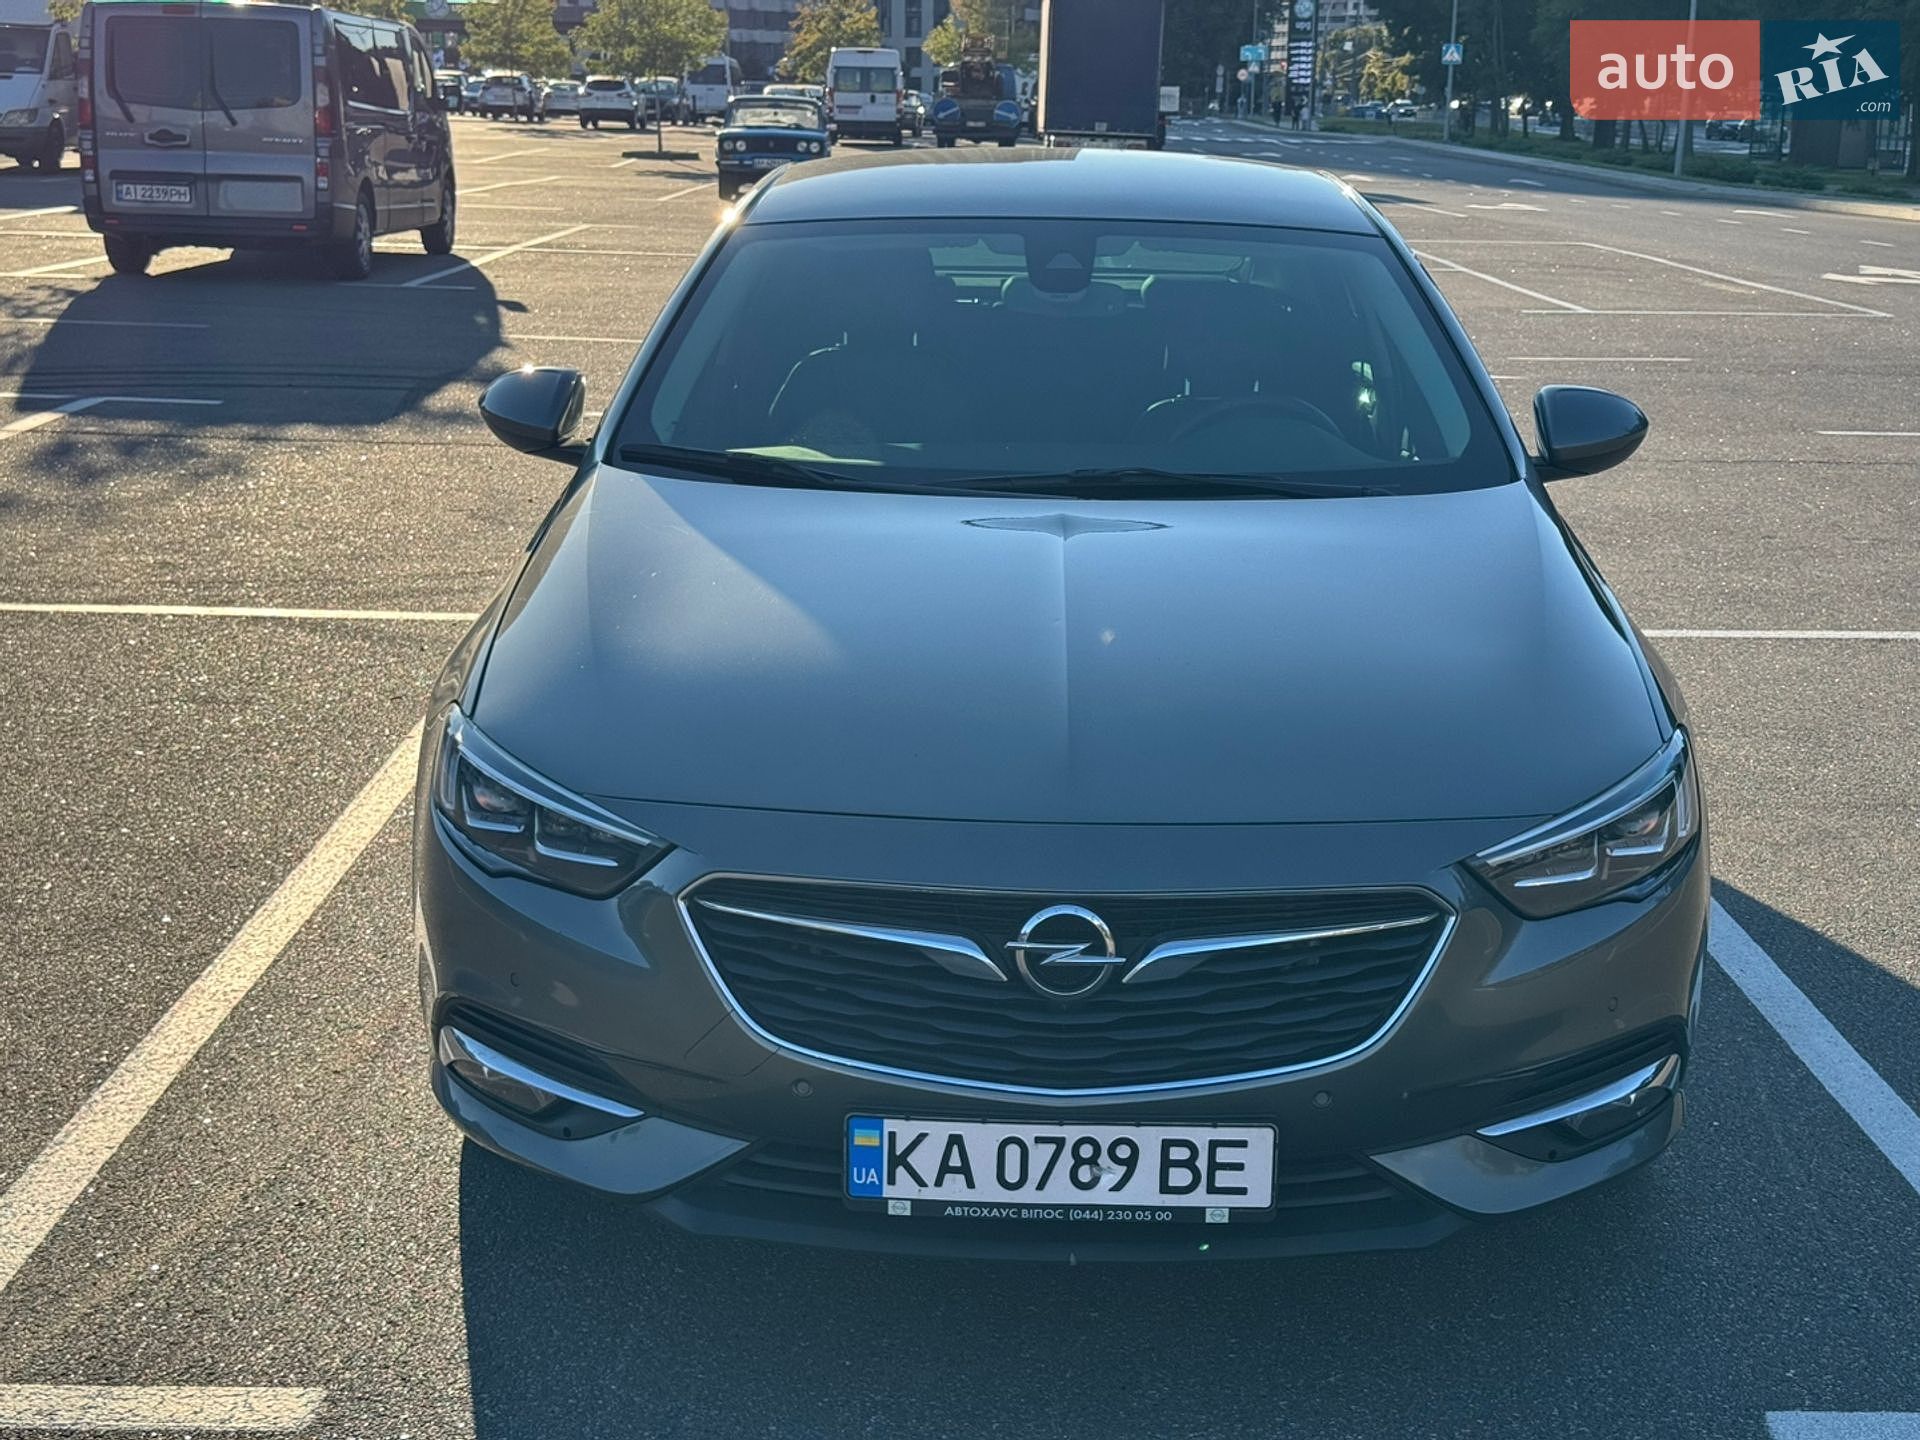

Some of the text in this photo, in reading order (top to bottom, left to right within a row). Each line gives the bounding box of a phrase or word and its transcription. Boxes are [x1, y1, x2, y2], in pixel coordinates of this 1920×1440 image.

[141, 185, 168, 201] 2239
[886, 1130, 1249, 1195] KA 0789 BE
[853, 1167, 880, 1185] UA
[944, 1205, 1018, 1219] АВТОХАУС
[1069, 1208, 1104, 1221] (044)
[1108, 1209, 1132, 1221] 230
[1135, 1210, 1152, 1221] 05
[1154, 1210, 1173, 1221] 00
